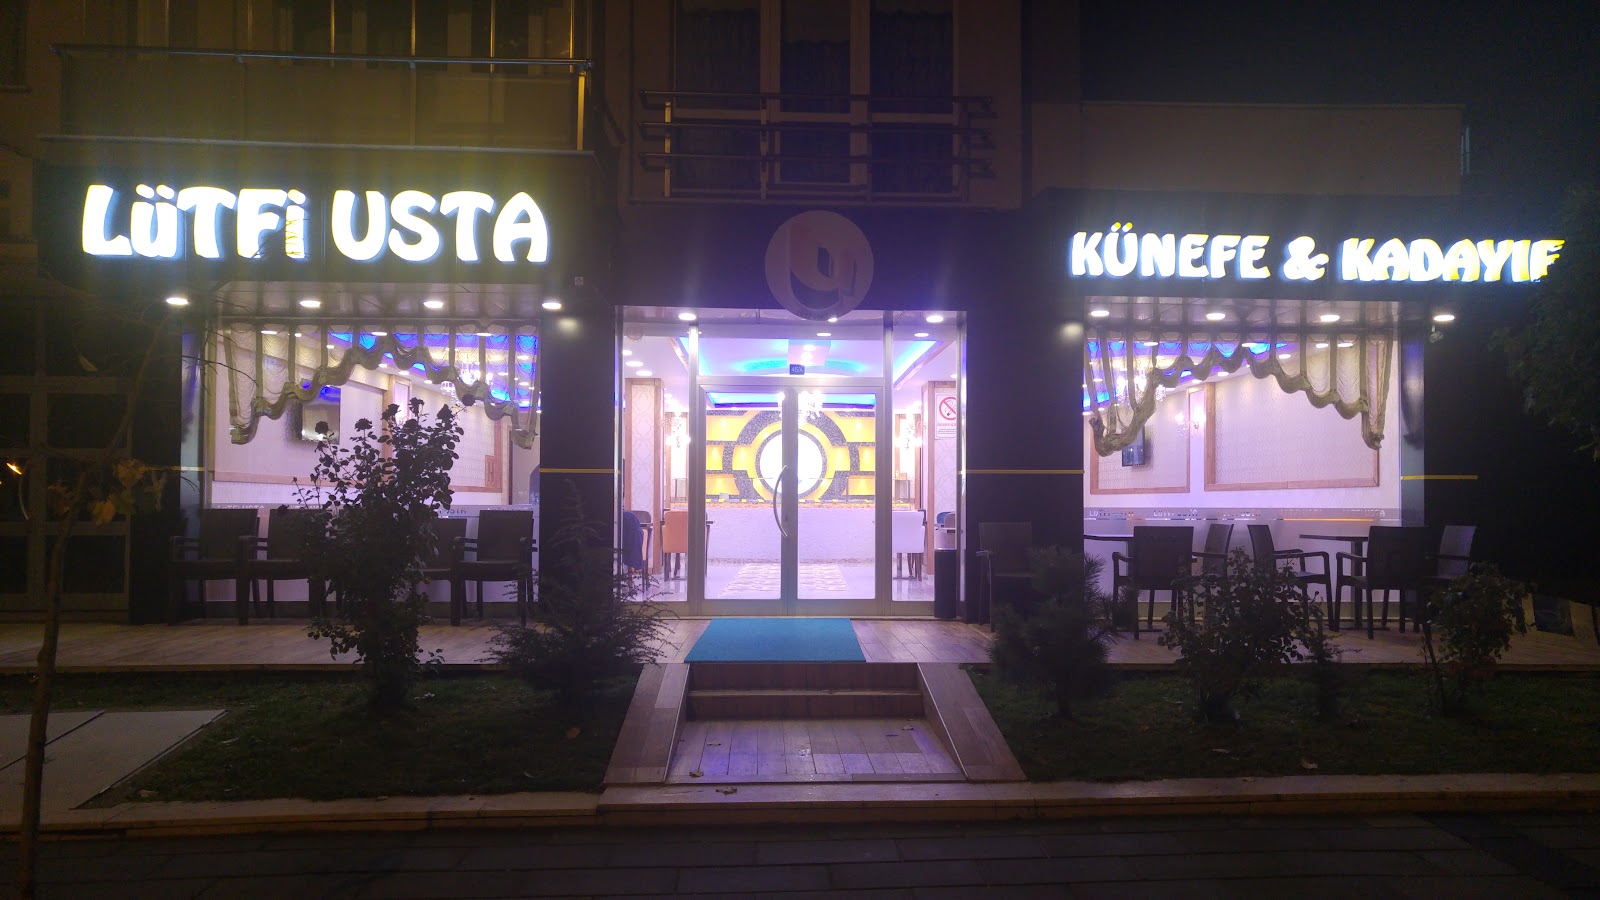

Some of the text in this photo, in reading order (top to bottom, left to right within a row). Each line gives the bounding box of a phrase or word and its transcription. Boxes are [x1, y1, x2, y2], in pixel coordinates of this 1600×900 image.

[332, 190, 549, 262] USTA
[1070, 222, 1565, 283] KÜNEFE & KADAYIF
